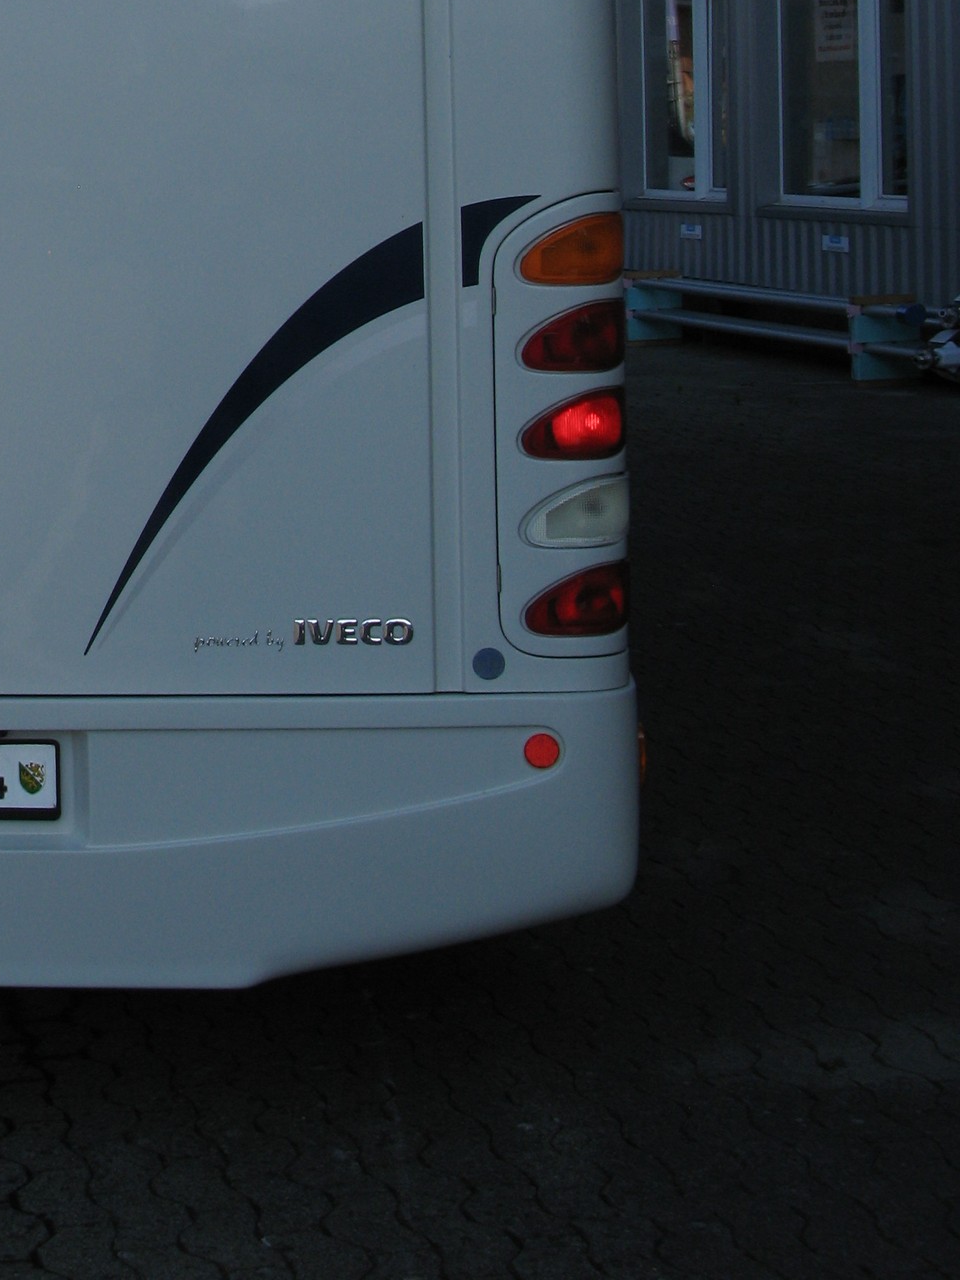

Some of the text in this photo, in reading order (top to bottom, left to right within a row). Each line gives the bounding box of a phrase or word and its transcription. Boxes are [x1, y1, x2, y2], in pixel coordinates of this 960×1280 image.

[193, 617, 414, 653] powered by IVECO
